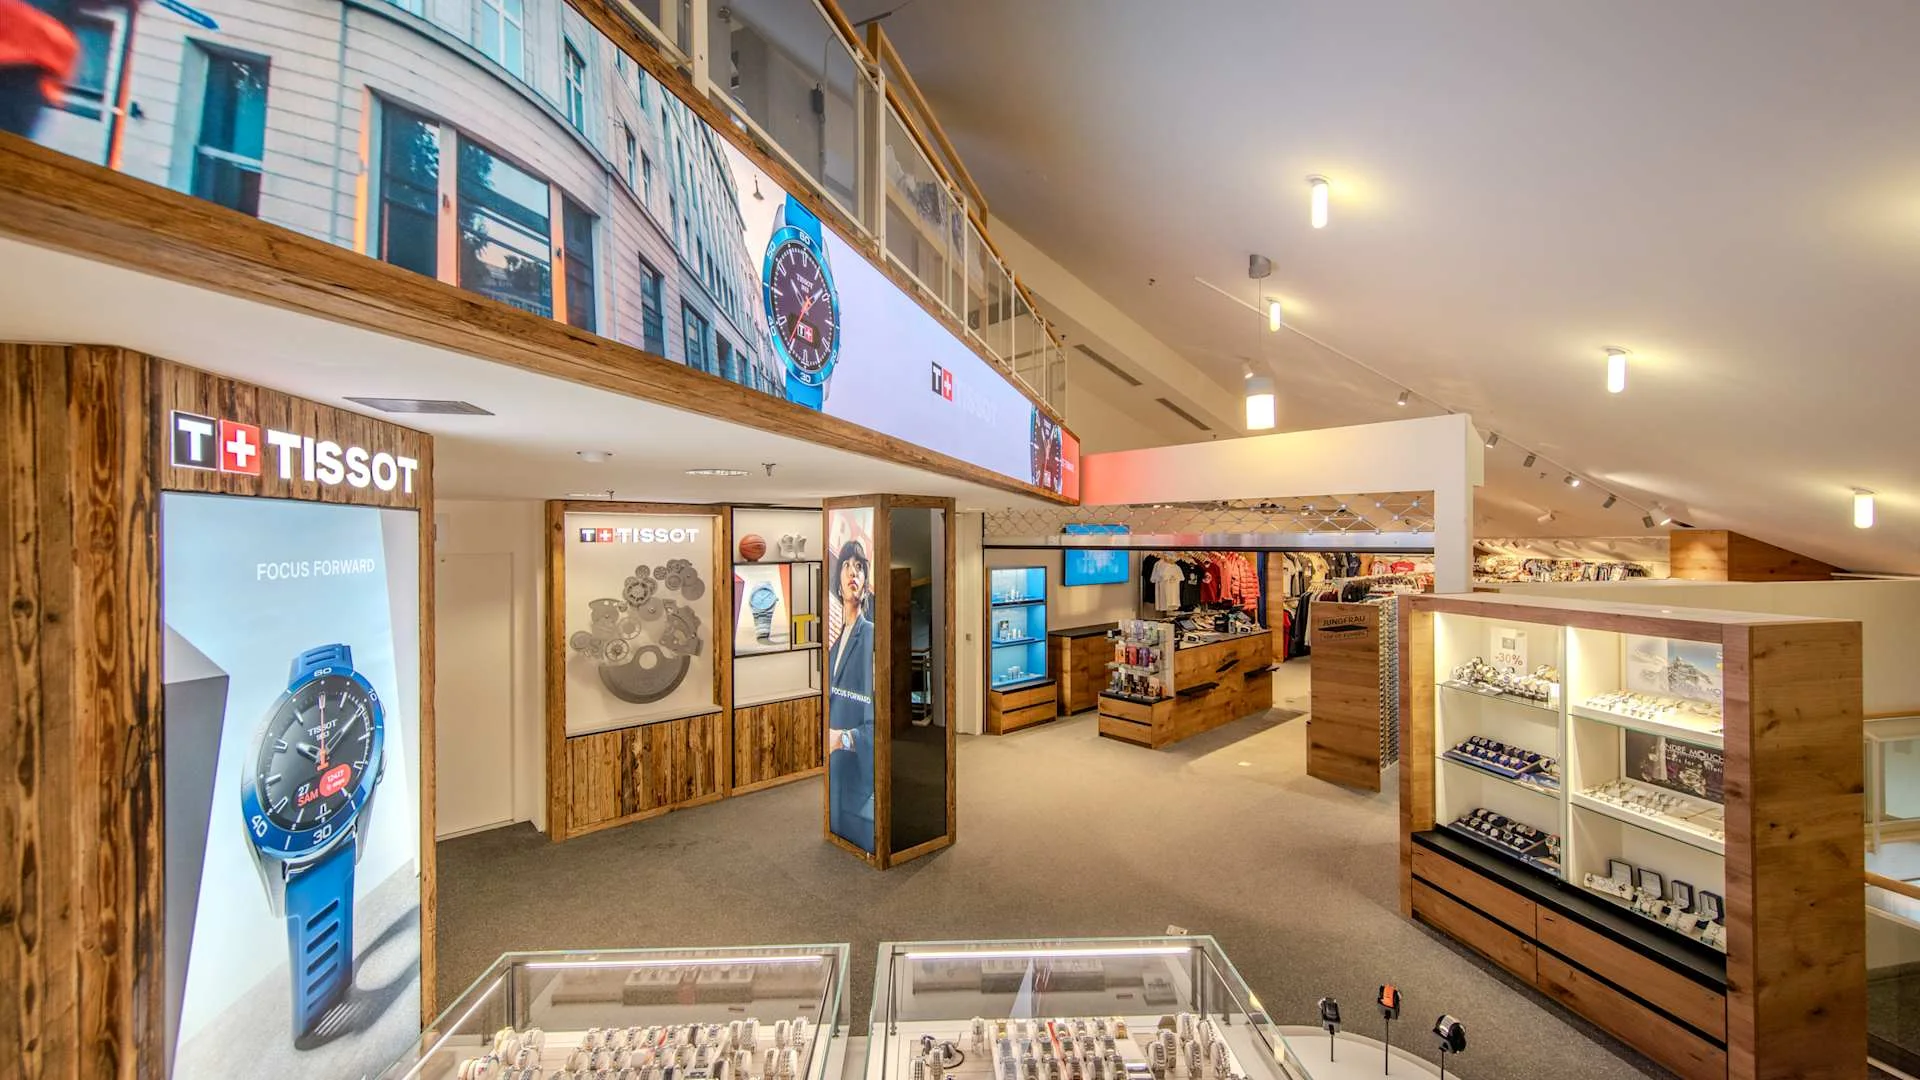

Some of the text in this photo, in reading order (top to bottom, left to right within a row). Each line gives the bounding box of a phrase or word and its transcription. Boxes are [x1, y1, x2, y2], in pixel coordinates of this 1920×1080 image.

[766, 243, 776, 259] 50
[799, 372, 811, 383] 30
[266, 428, 418, 493] TISSOT
[617, 528, 699, 543] TISSOT
[256, 557, 376, 581] FOCUS FORWARD
[1322, 615, 1366, 626] JUNGFRAU
[1495, 652, 1524, 666] -30%
[831, 686, 871, 704] FOCUS FORWARD
[297, 788, 319, 807] SAM
[298, 783, 311, 797] 27
[251, 814, 268, 838] 40
[312, 823, 332, 845] 30
